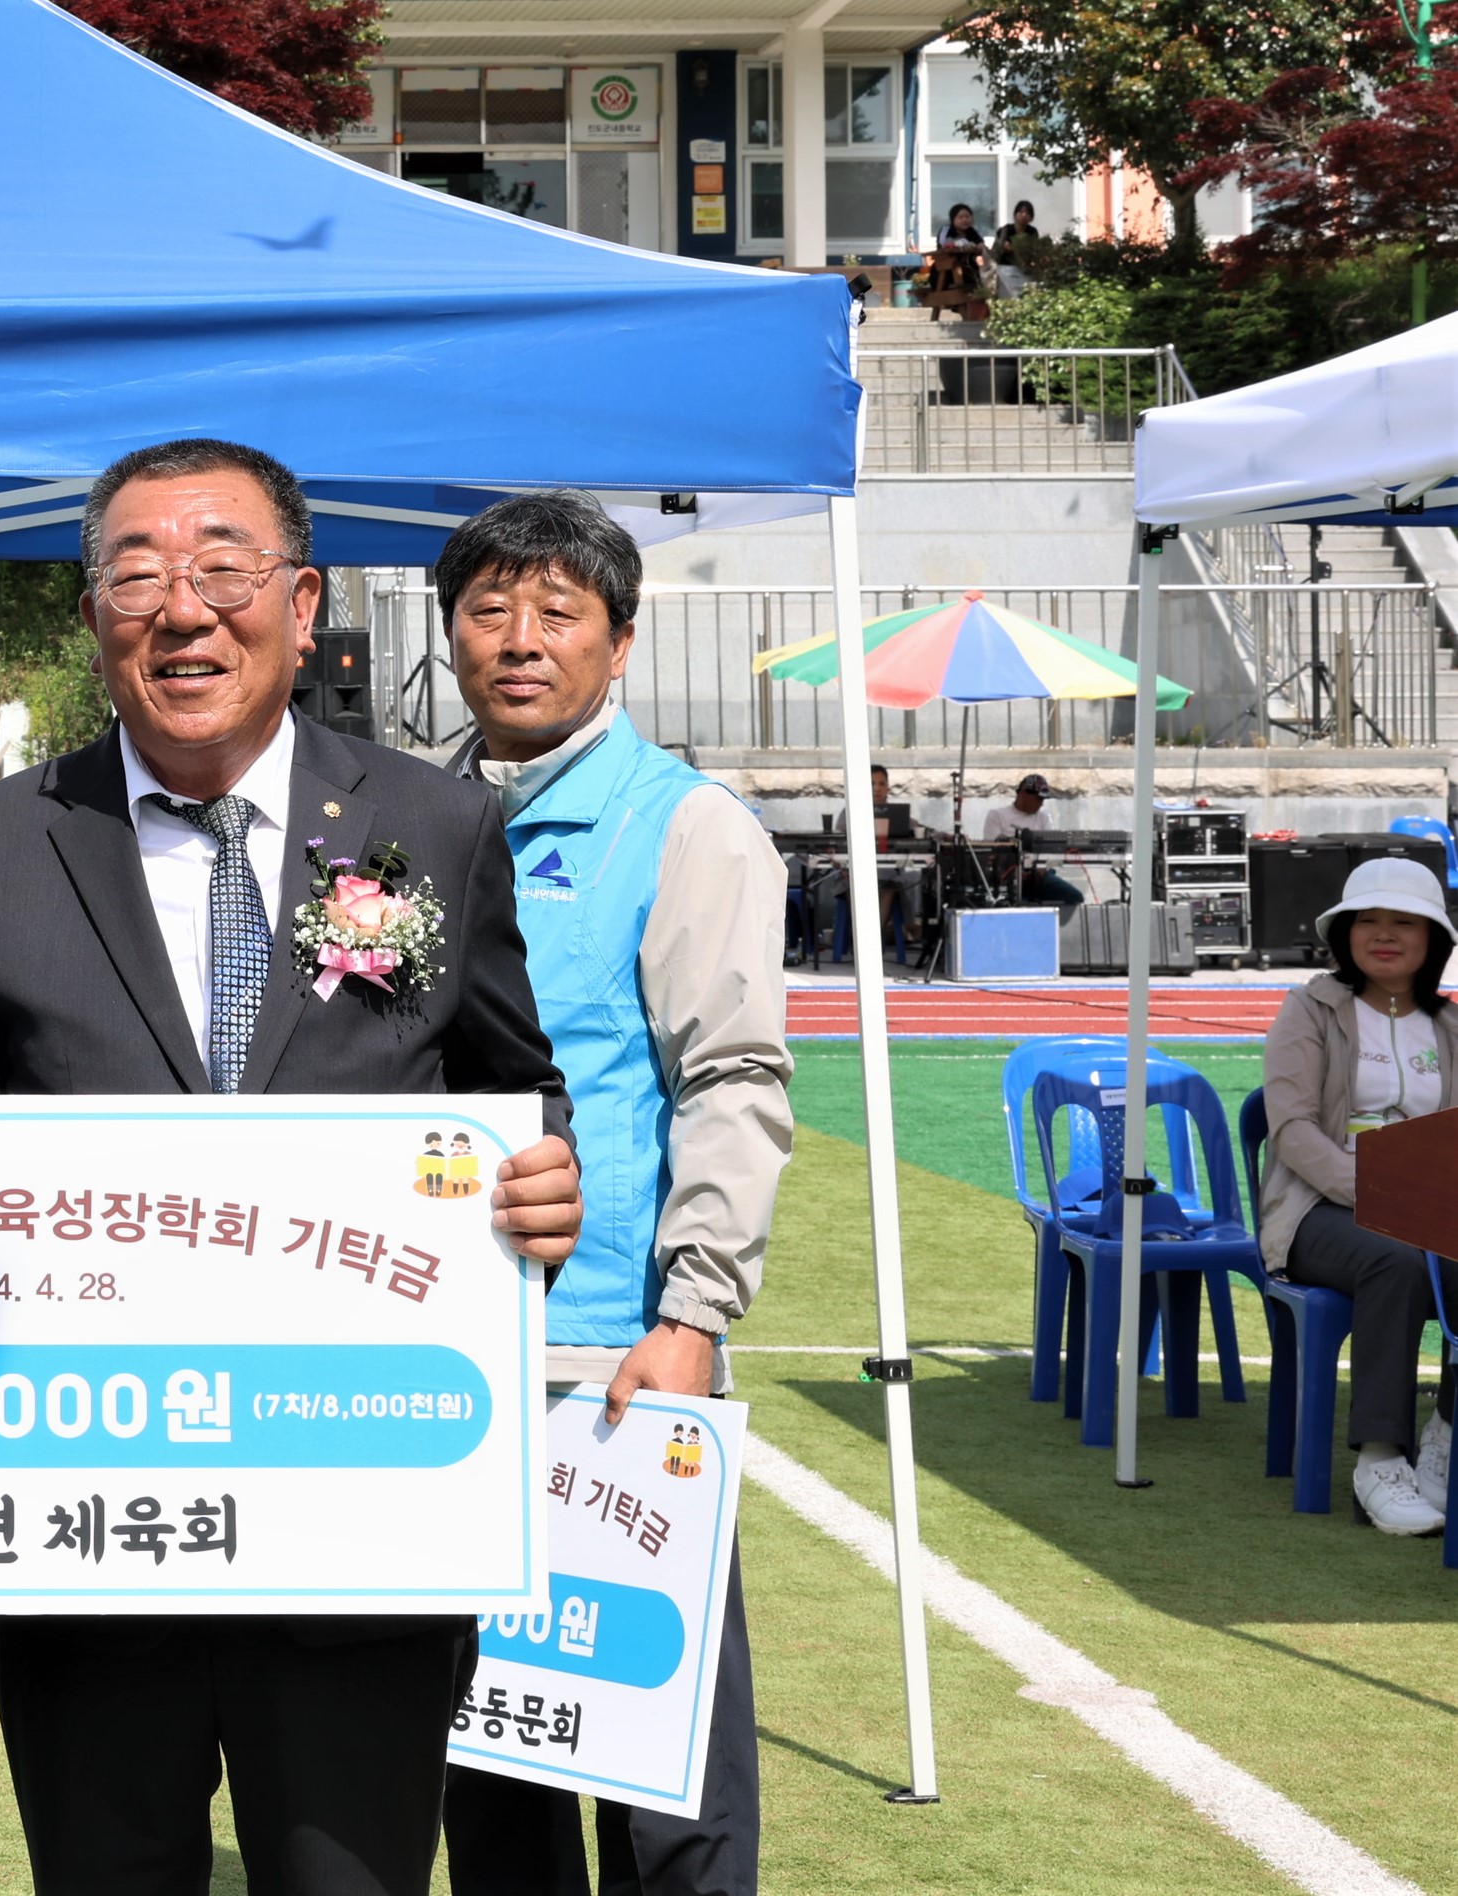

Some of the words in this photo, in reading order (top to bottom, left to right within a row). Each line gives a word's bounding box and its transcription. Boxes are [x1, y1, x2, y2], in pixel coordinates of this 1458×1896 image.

[588, 124, 641, 133] 진도군내중학교
[281, 1216, 442, 1304] 기탁금
[35, 1272, 64, 1302] 4.
[78, 1272, 125, 1302] 28.
[252, 1393, 474, 1421] (7차/8,000천원)
[42, 1493, 238, 1566] 체육회
[584, 1478, 672, 1558] 기탁금
